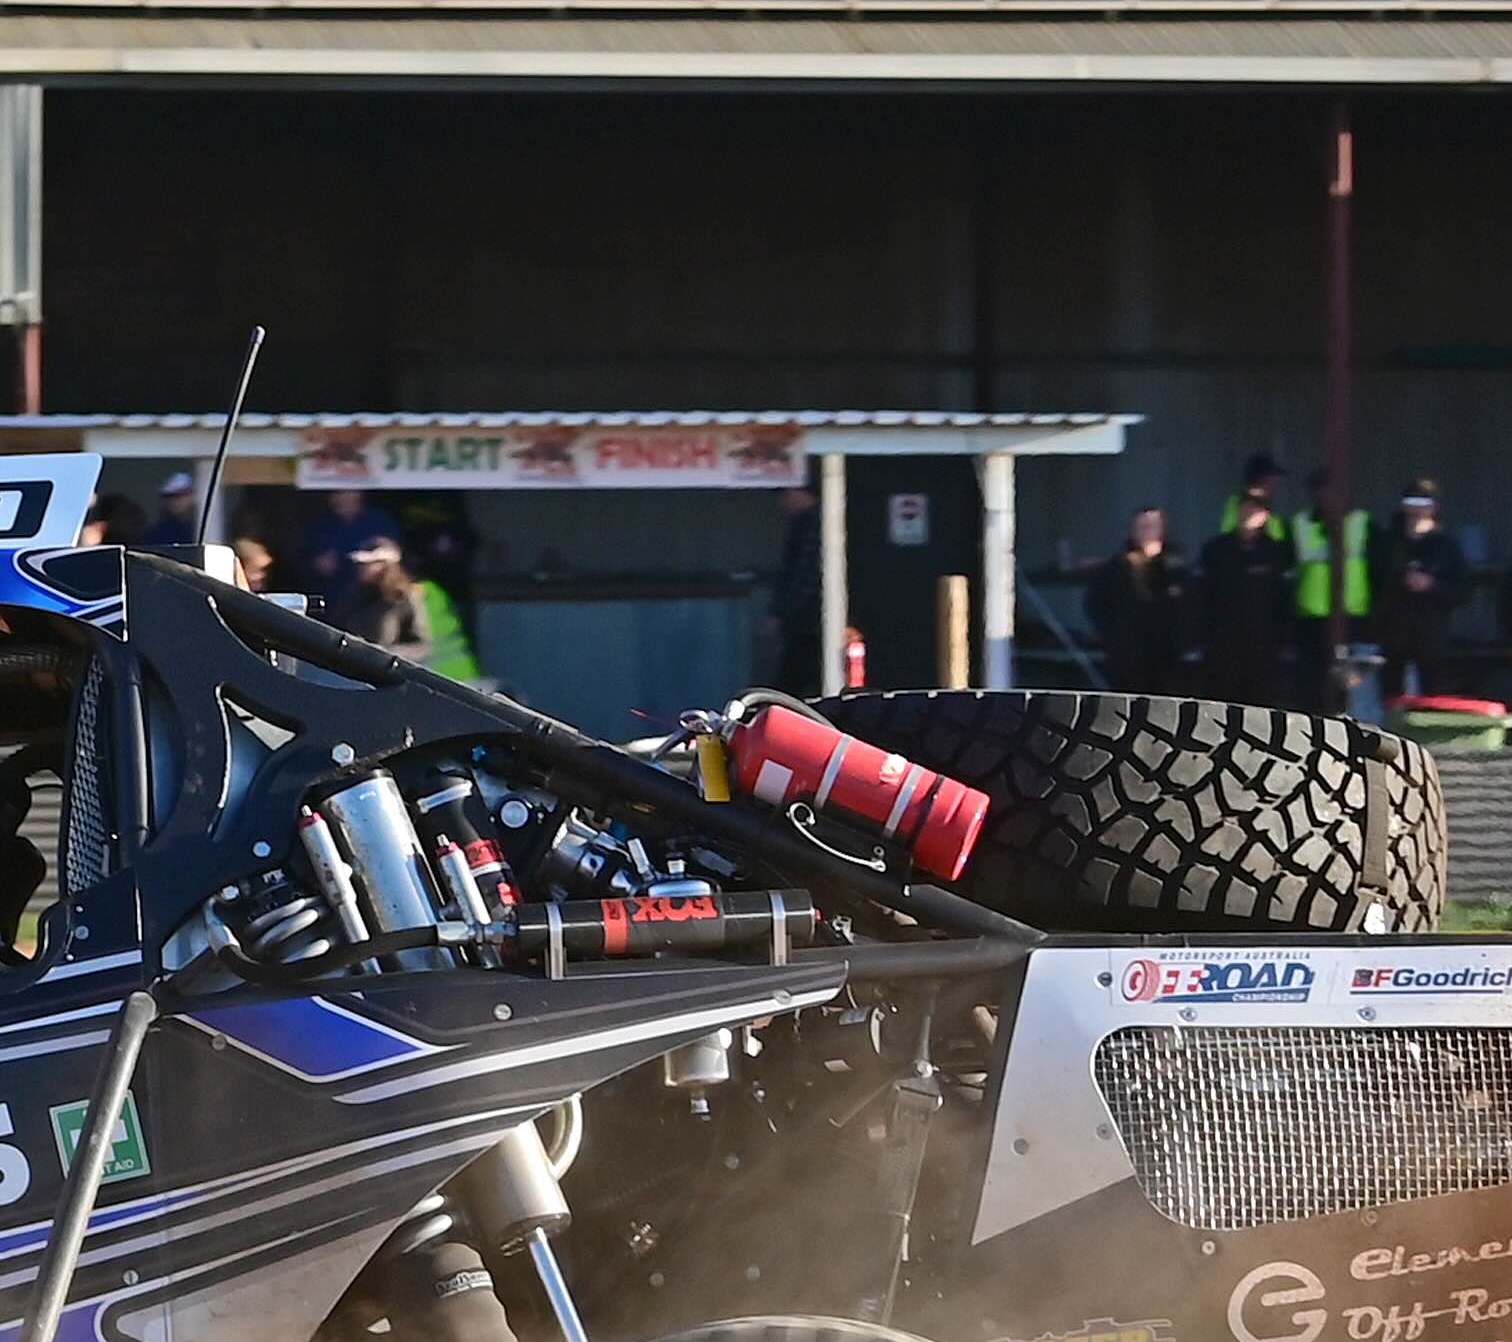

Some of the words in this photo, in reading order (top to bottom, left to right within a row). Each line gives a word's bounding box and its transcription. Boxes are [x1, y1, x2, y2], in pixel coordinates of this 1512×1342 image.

[383, 437, 504, 471] START
[594, 437, 720, 470] FINISH
[1159, 952, 1239, 960] MOTORSPORT
[1245, 951, 1311, 960] AUSTRALIA
